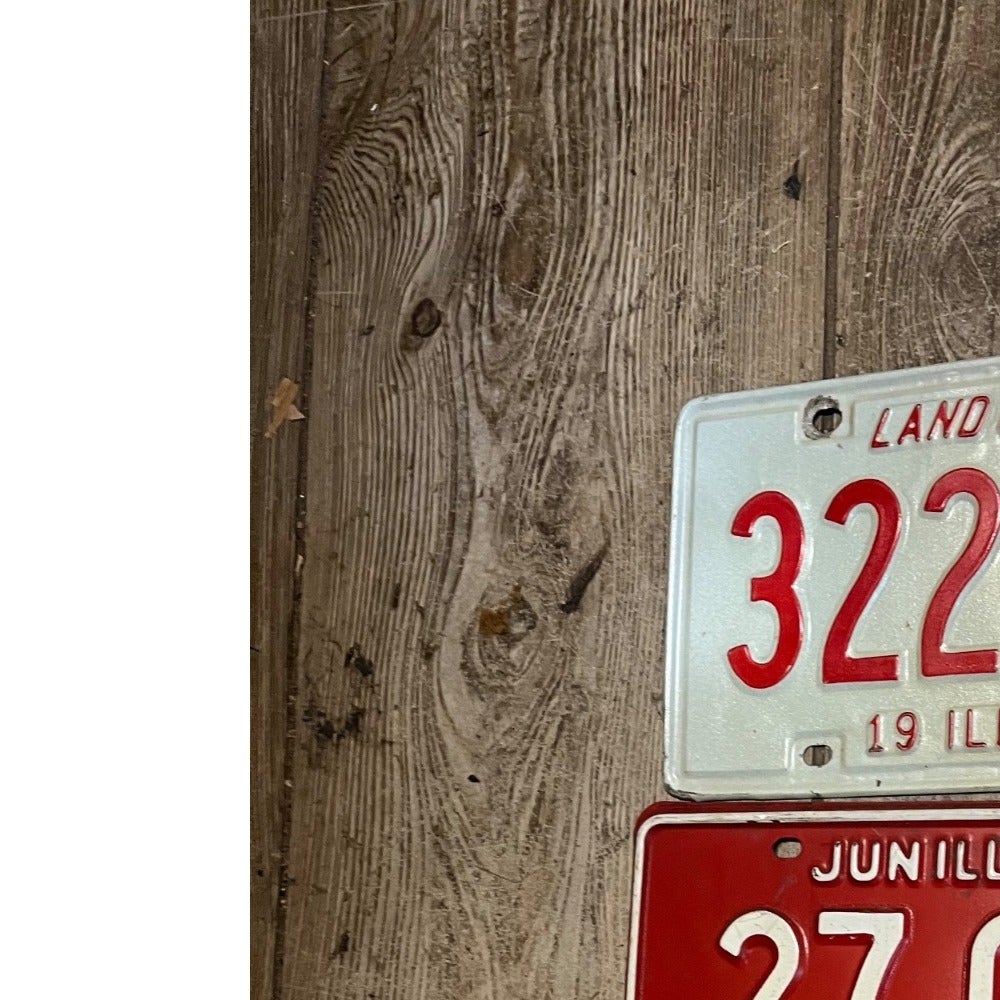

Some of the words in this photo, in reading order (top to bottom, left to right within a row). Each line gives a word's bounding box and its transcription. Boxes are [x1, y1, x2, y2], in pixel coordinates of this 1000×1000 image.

[871, 398, 986, 449] LAND
[726, 467, 999, 689] 322
[868, 712, 918, 753] 19
[811, 840, 920, 883] JUN
